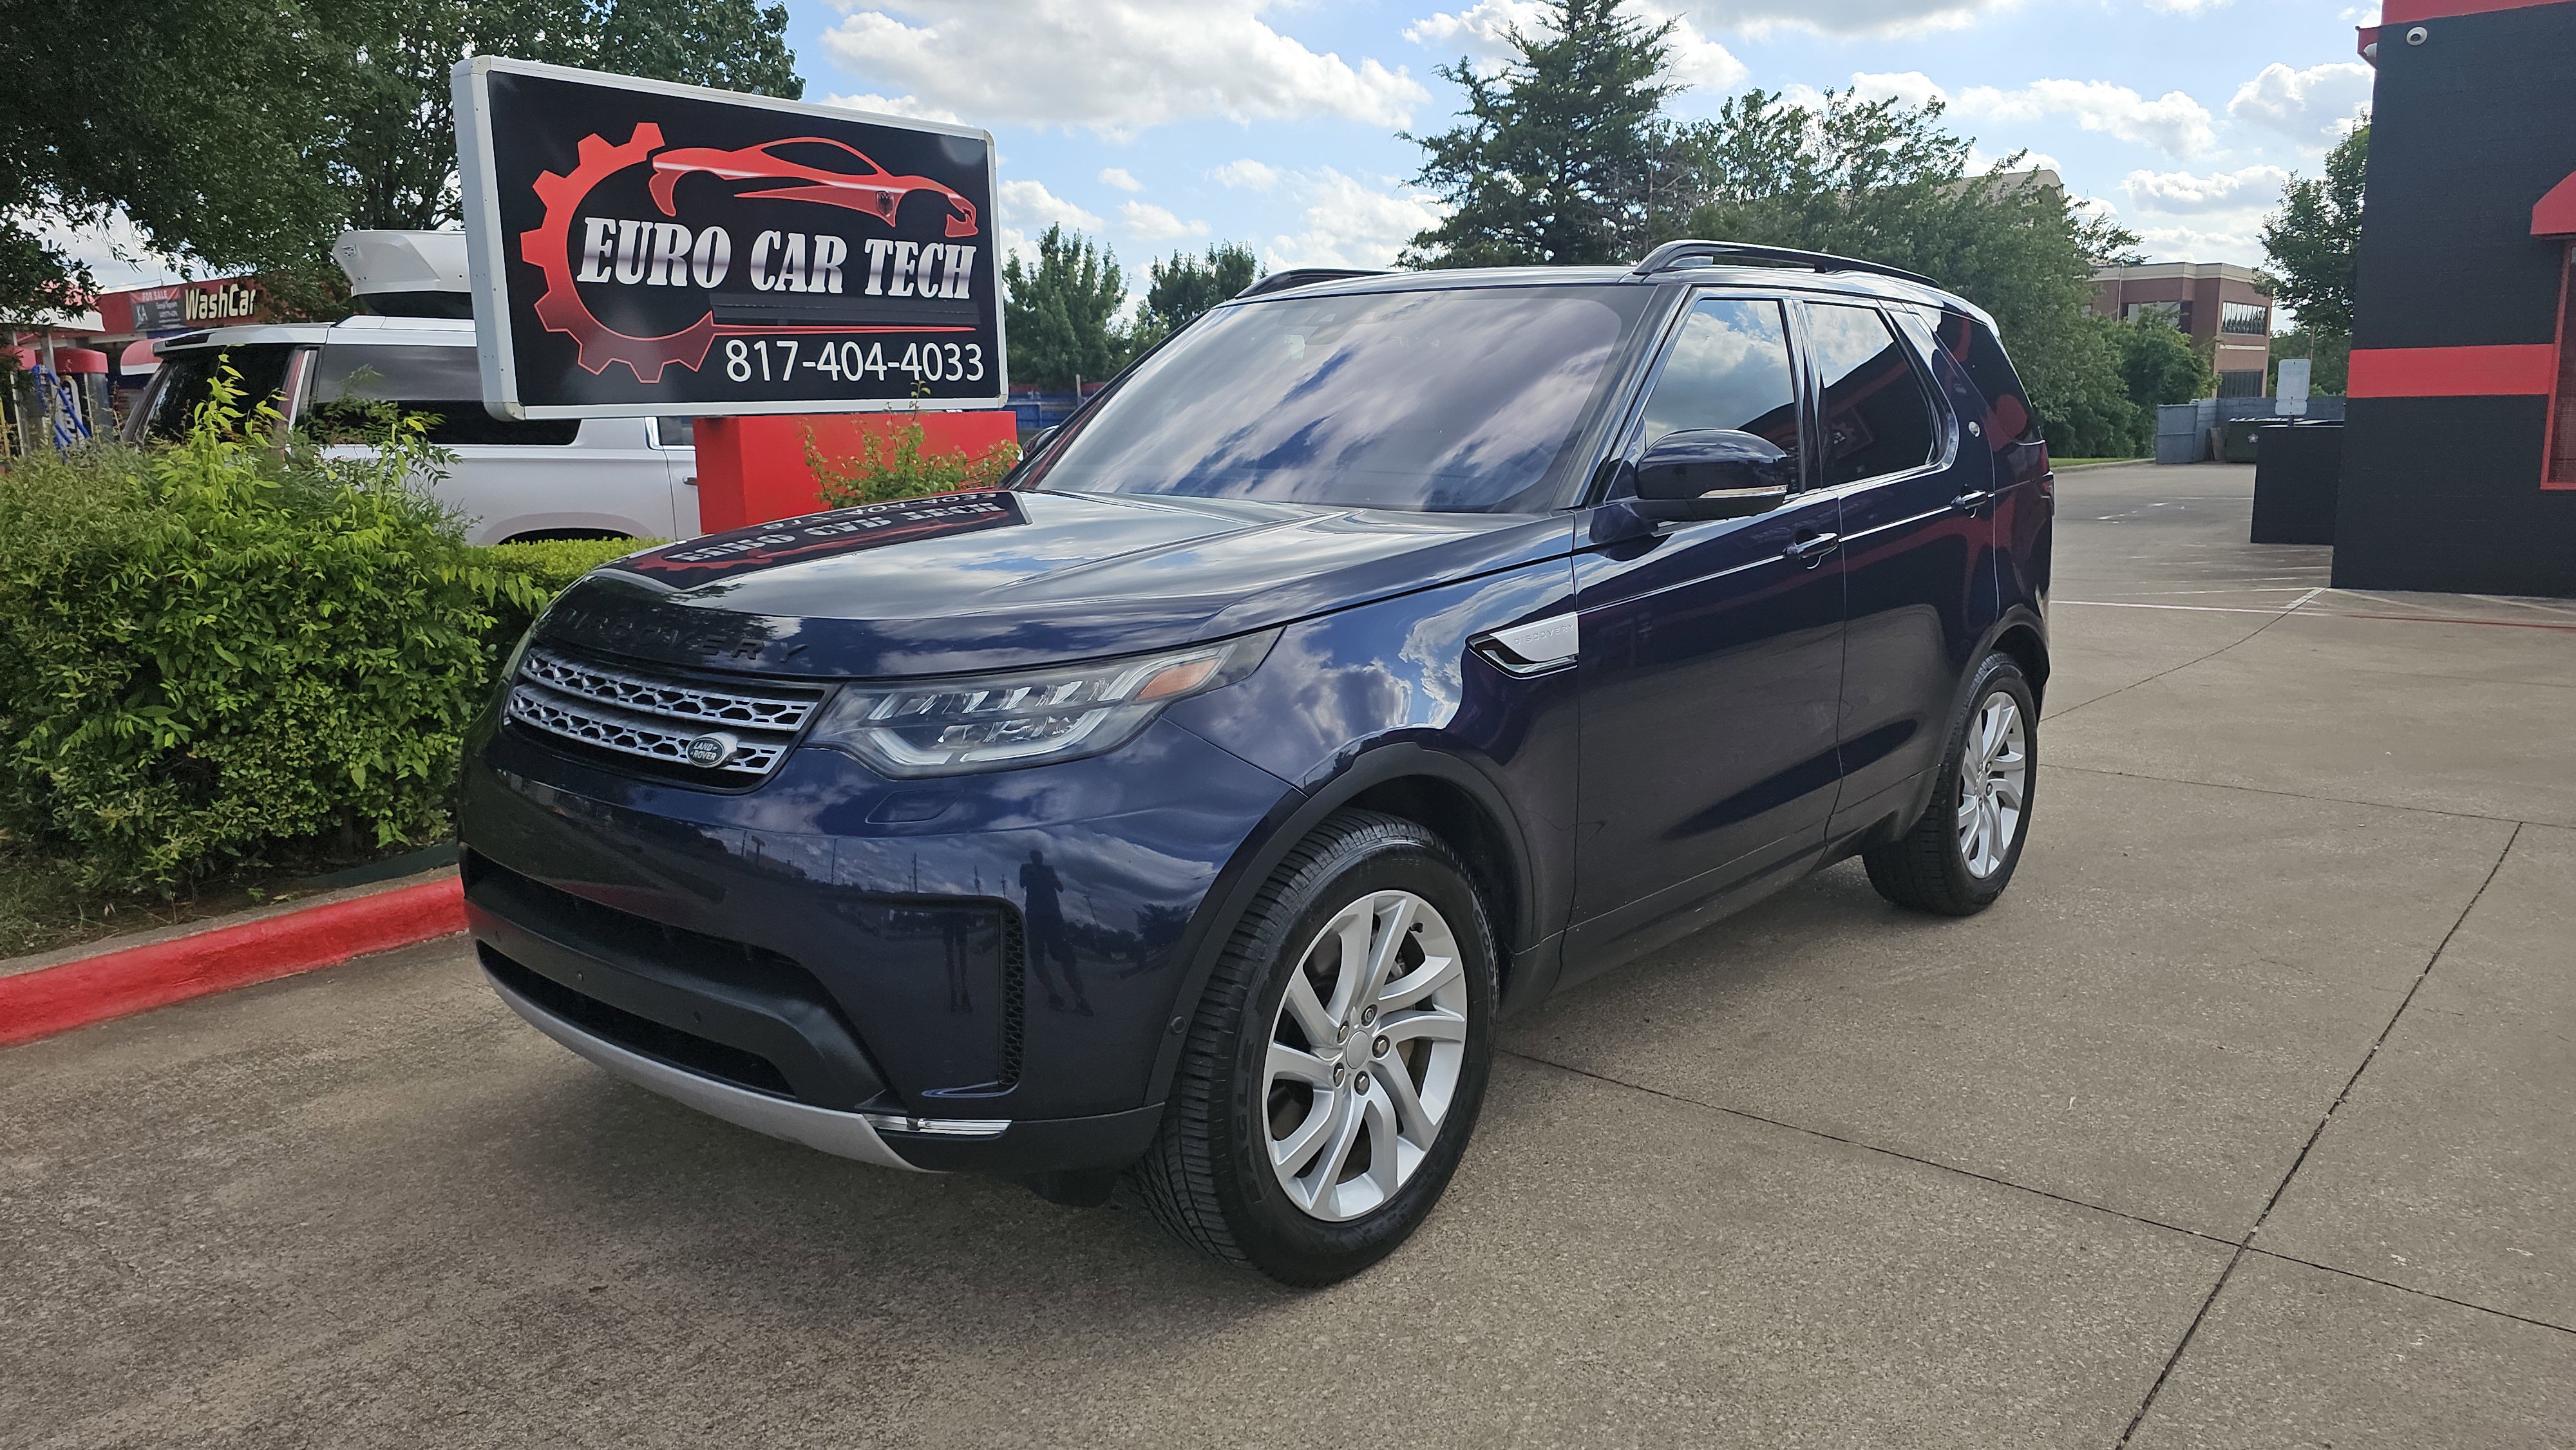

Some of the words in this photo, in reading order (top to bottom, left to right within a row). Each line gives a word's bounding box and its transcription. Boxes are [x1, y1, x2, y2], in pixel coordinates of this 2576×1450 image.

[577, 217, 732, 288] EURO
[750, 230, 848, 294] CAR
[864, 238, 977, 299] TECH
[142, 292, 153, 301] FOR
[153, 290, 167, 301] SALE
[185, 283, 256, 321] WashCar
[725, 339, 985, 382] 817-404-4033
[1514, 623, 1575, 646] DISCOVERY
[692, 750, 717, 761] ROVER
[693, 741, 714, 751] LAND
